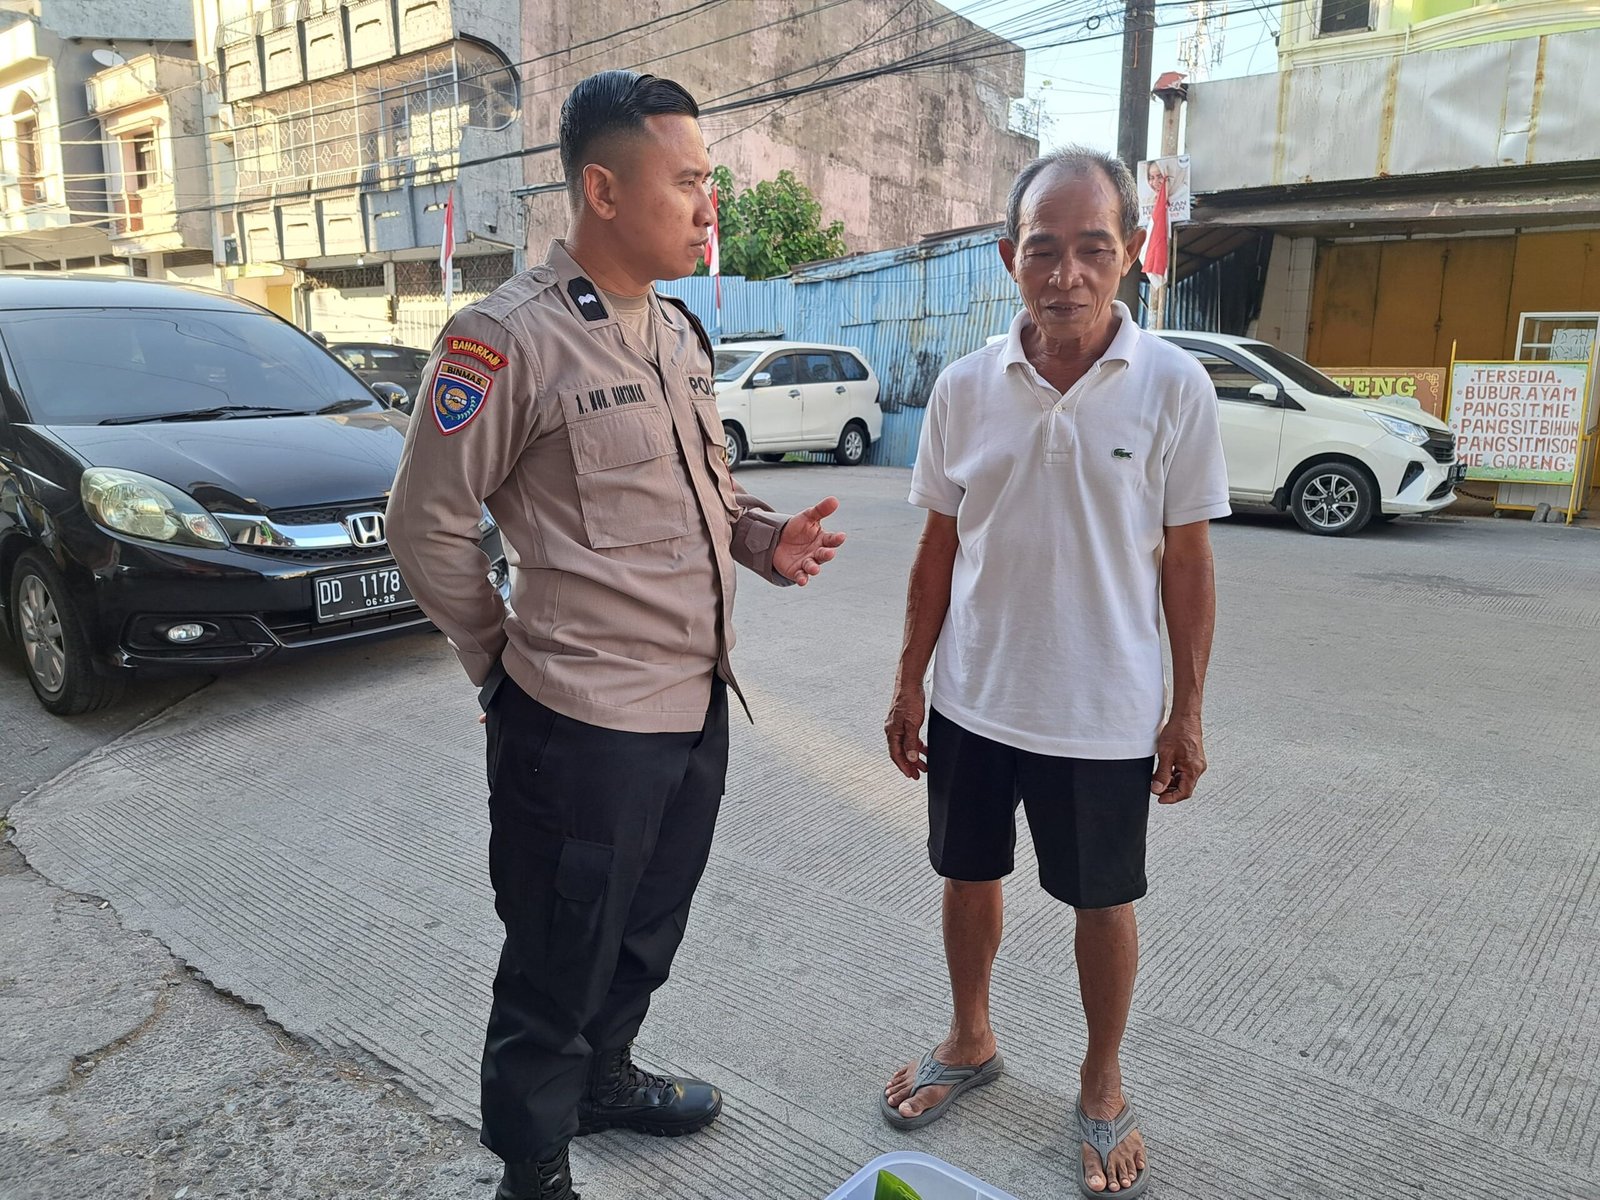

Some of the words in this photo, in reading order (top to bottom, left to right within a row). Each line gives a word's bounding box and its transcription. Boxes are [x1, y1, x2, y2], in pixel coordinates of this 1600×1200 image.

[447, 365, 482, 385] BINMAS
[1457, 453, 1483, 467] MIE
[1493, 454, 1566, 471] GORENG
[320, 580, 342, 605] DD
[360, 570, 400, 597] 1178
